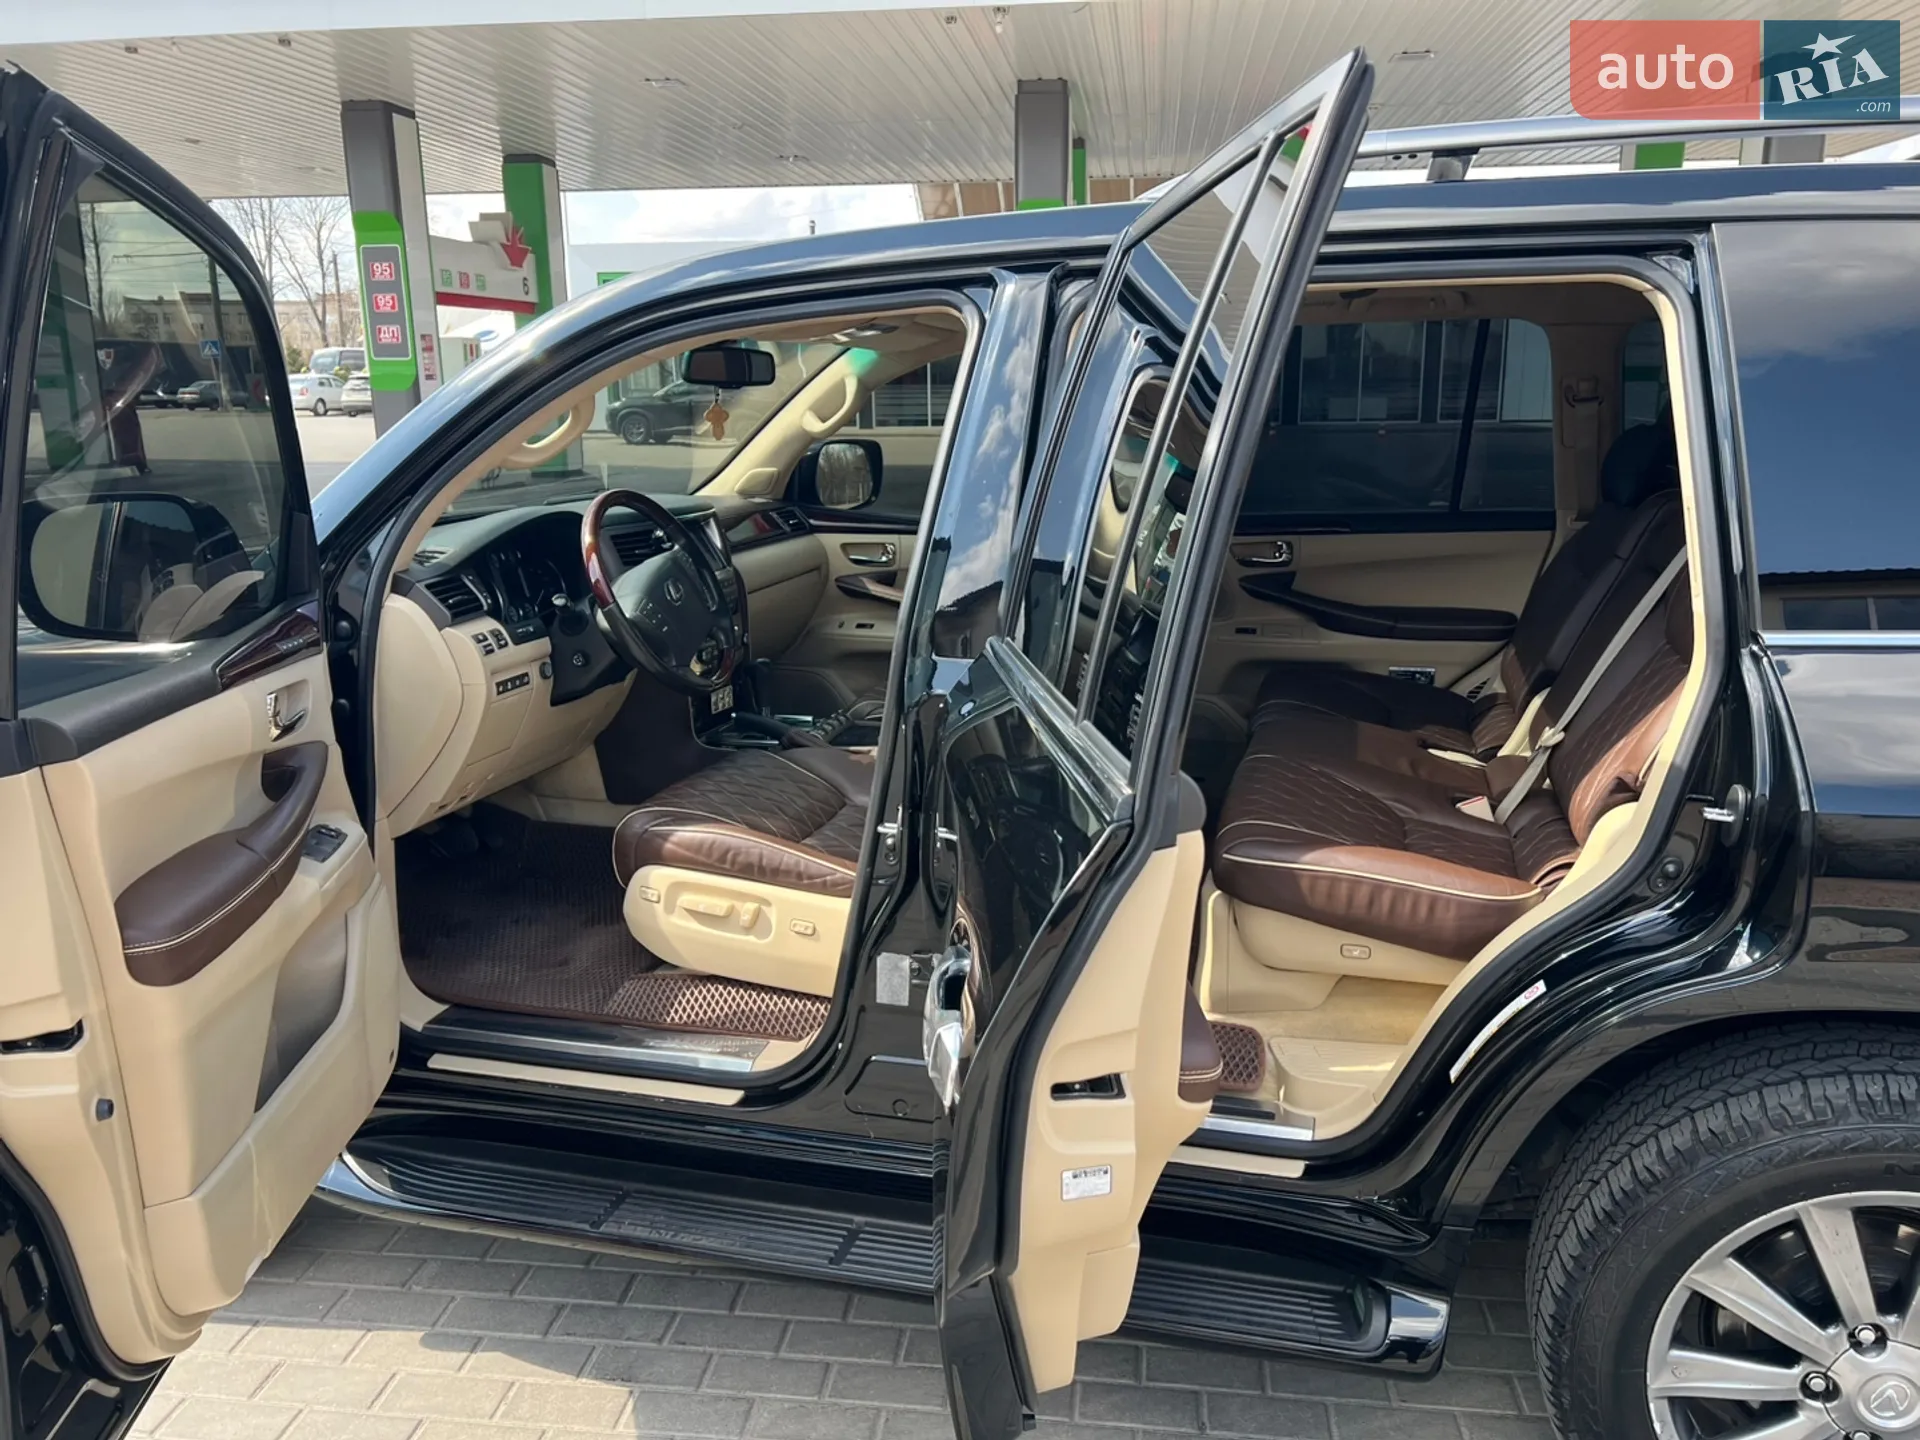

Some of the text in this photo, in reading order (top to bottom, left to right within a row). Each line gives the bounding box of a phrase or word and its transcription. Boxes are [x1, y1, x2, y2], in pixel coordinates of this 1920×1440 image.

[373, 262, 391, 275] 95
[523, 277, 530, 296] 6
[377, 295, 393, 307] 95
[379, 327, 398, 338] ДП
